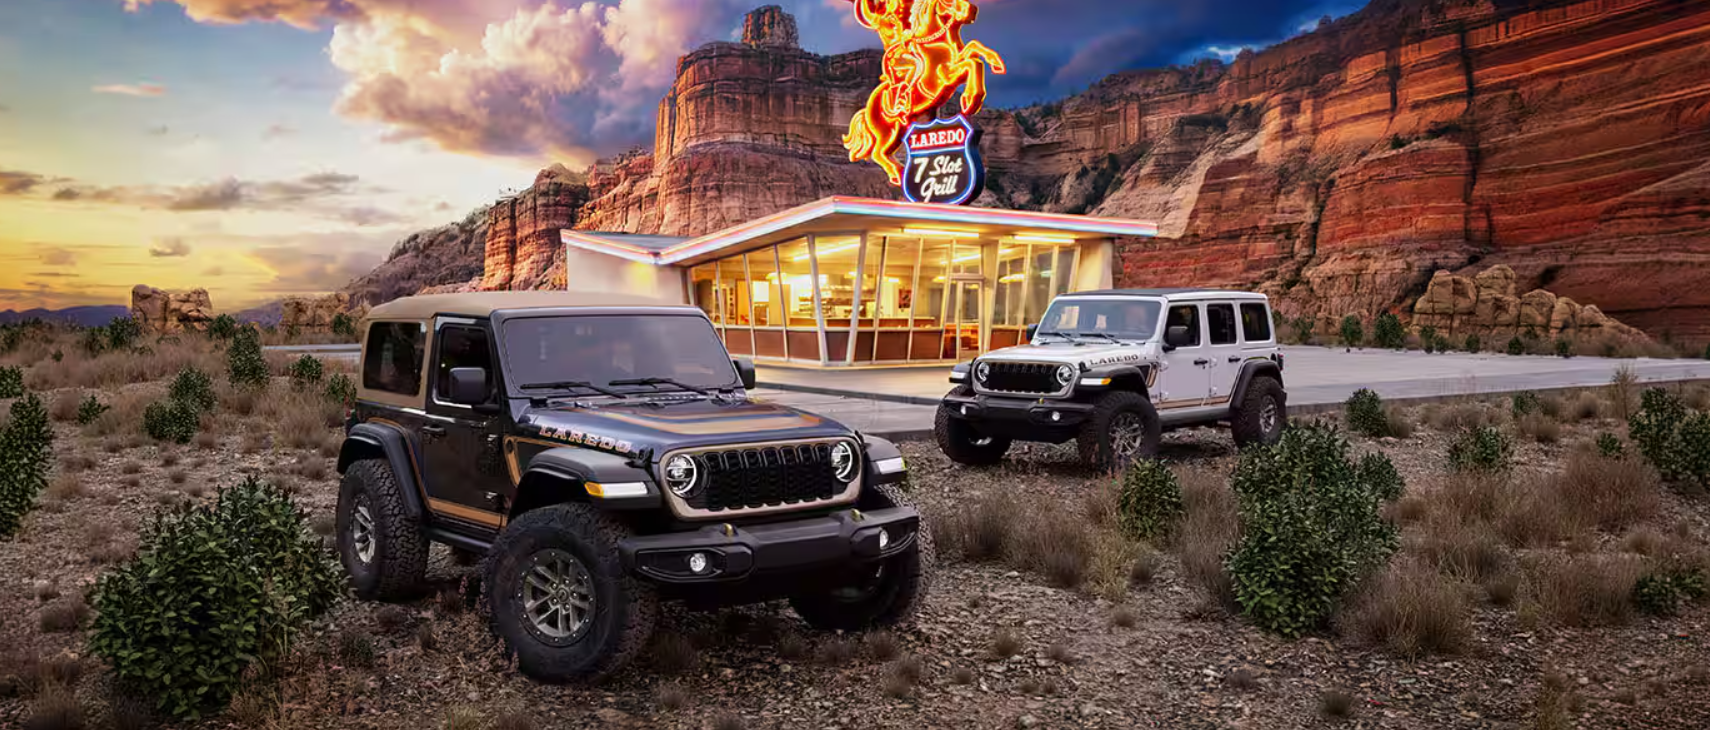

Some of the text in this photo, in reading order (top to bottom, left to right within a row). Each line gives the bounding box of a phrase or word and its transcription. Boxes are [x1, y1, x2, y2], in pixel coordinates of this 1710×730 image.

[910, 128, 965, 148] LAREDO
[914, 155, 963, 183] 7 Slot
[920, 175, 959, 203] Grill
[1090, 354, 1139, 365] LAREDO
[539, 424, 632, 453] LAREDO
